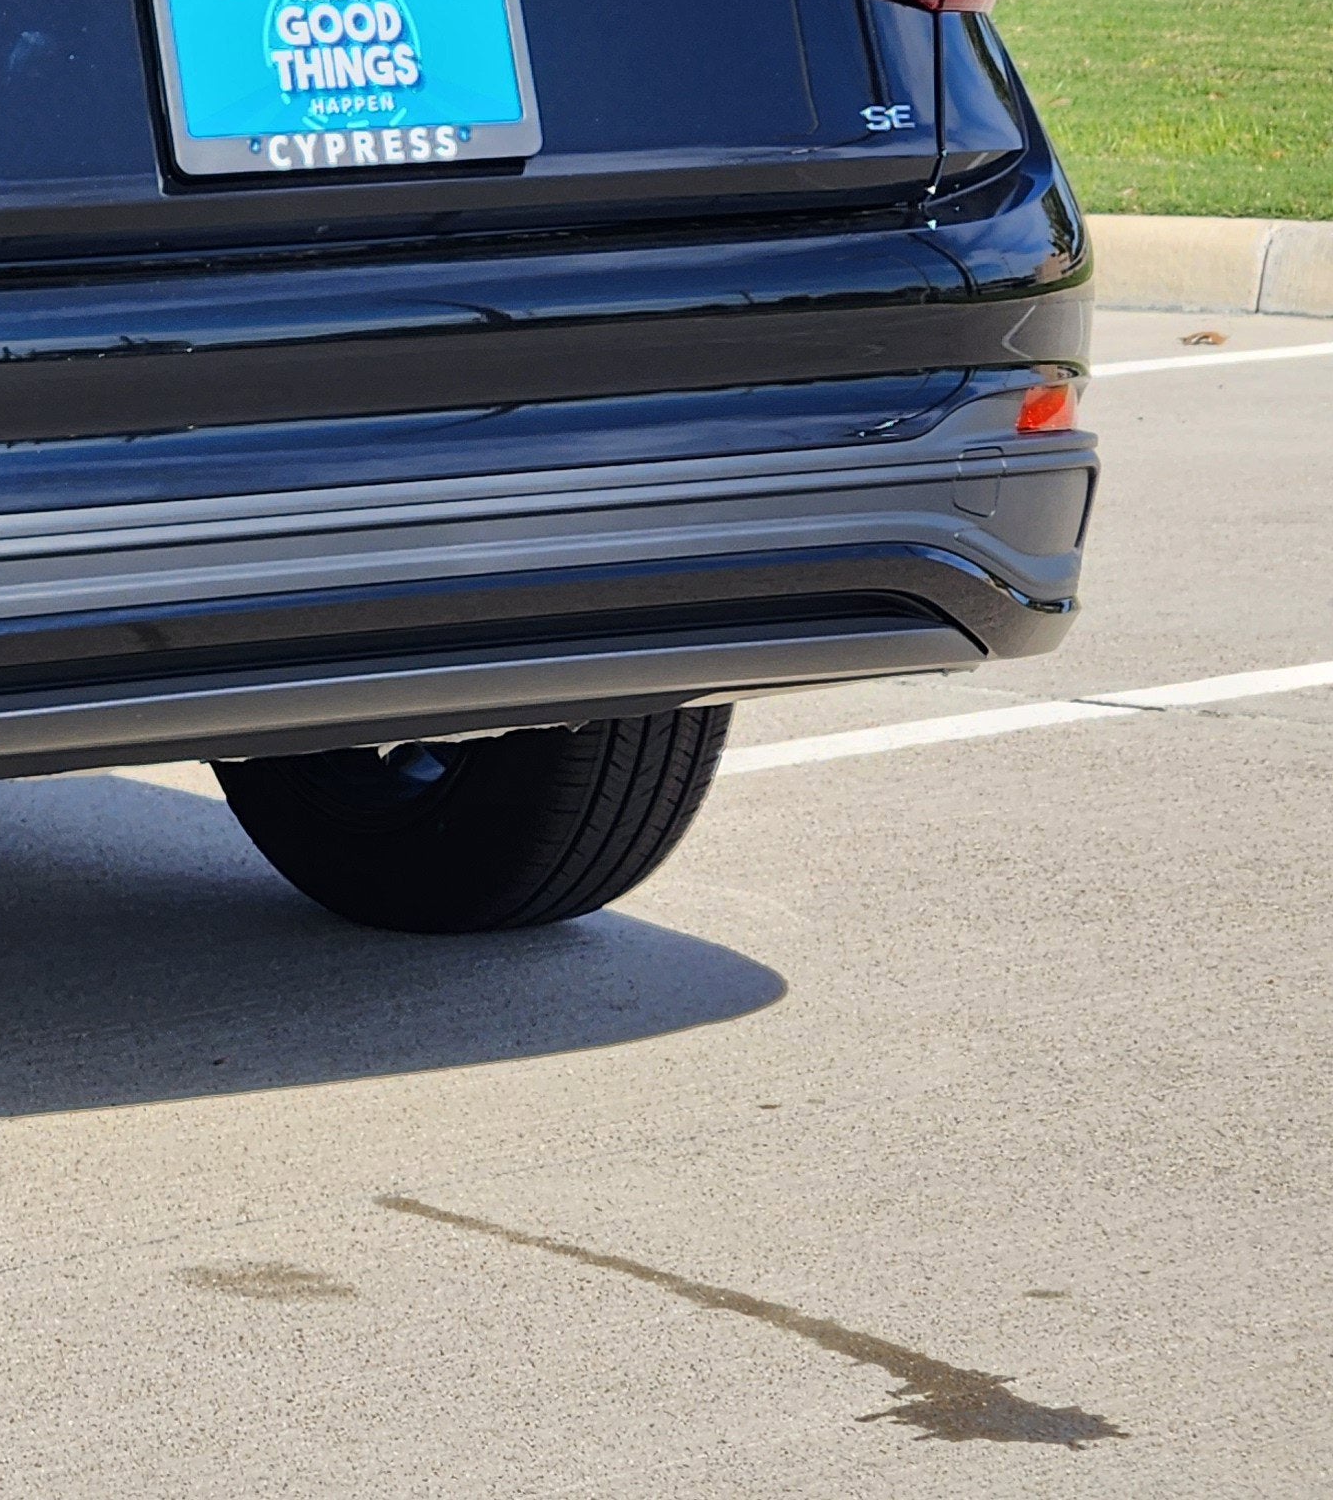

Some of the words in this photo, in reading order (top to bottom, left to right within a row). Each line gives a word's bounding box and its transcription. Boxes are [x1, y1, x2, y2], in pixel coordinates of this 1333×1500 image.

[276, 2, 402, 45] GOOD
[271, 44, 418, 91] THINGS
[311, 92, 394, 115] HAPPEN
[861, 105, 915, 131] SE
[268, 125, 458, 170] CYPRESS
